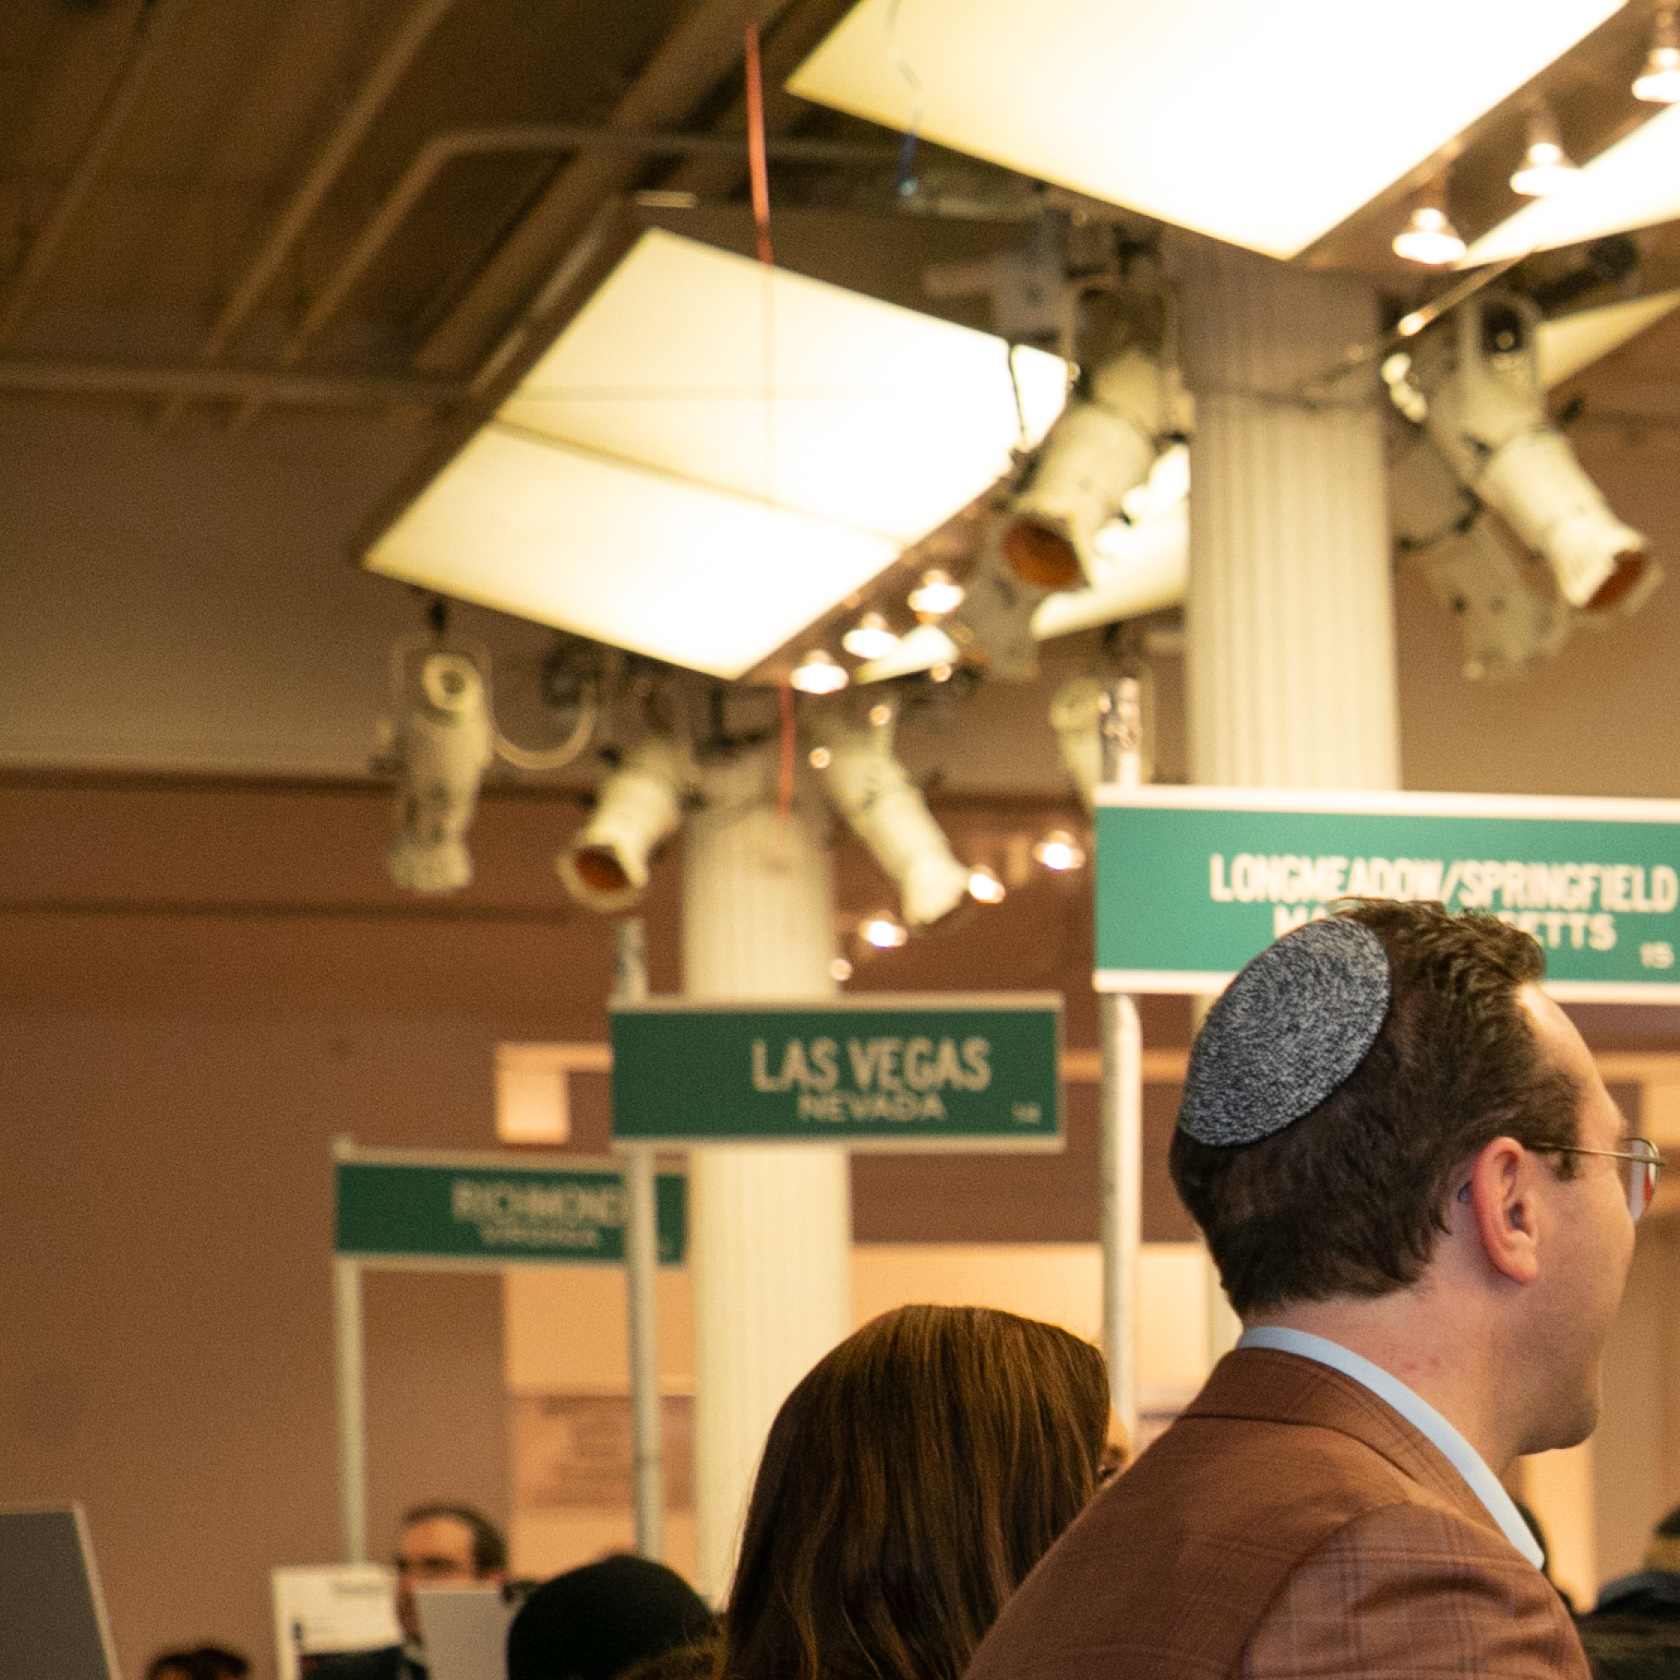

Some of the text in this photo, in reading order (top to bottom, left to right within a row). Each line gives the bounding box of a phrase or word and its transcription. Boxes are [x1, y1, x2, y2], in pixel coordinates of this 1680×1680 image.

[1209, 852, 1679, 913] LONGMEADOW/SPRINGFIELD
[752, 1036, 992, 1093] LAS VEGAS
[798, 1091, 948, 1122] NEVADA
